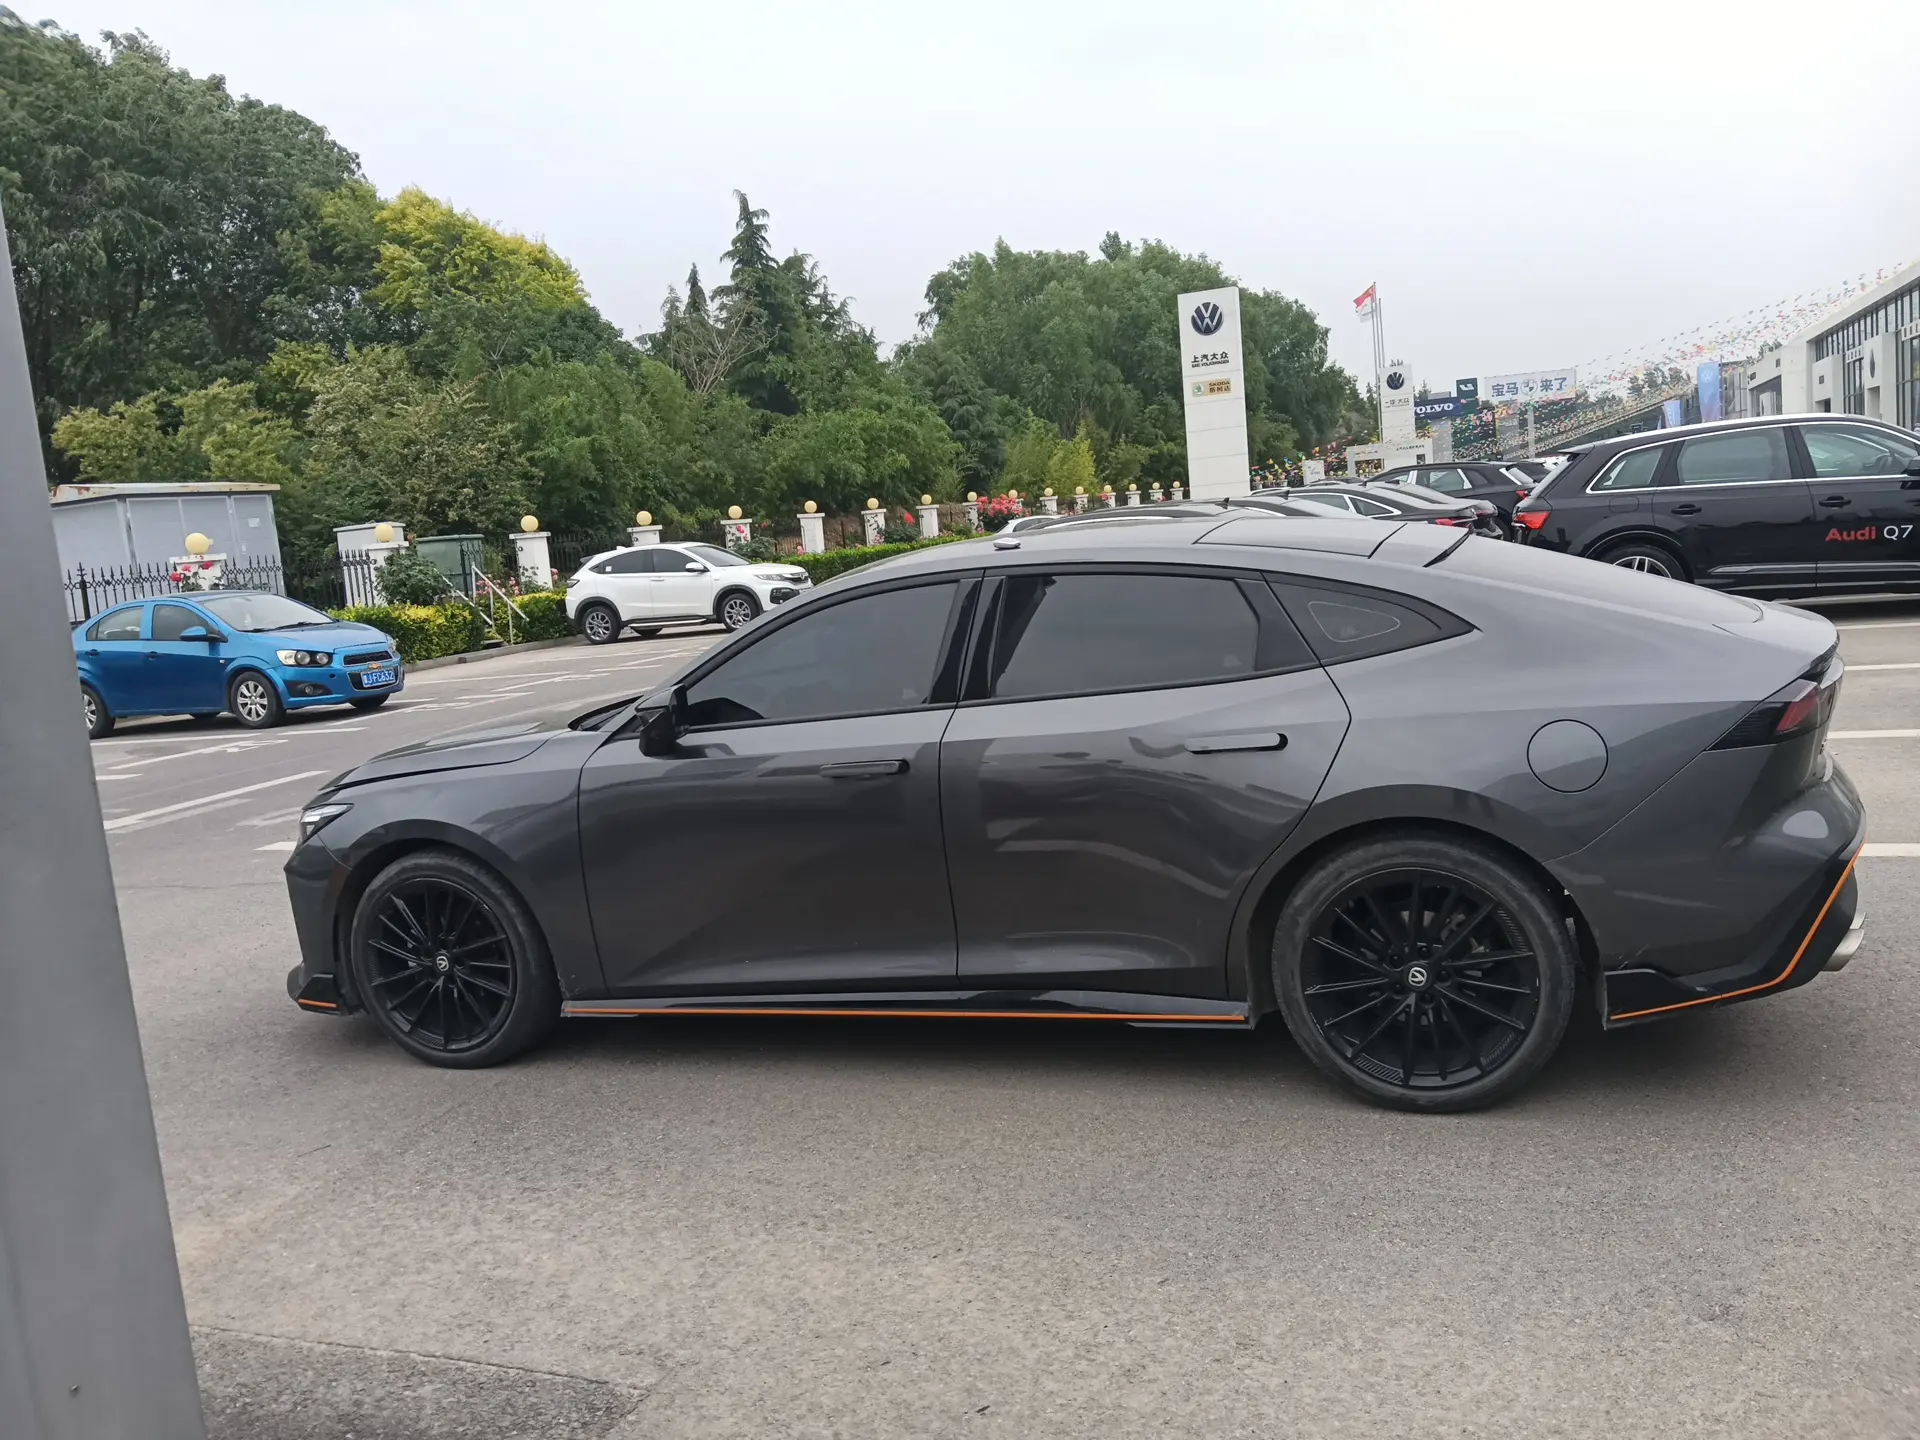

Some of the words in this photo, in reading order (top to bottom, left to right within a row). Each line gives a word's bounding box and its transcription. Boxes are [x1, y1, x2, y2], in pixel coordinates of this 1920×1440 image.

[1191, 351, 1229, 363] 上汽大众
[1492, 382, 1519, 397] 宝马
[1540, 377, 1567, 392] 来了
[1825, 526, 1877, 542] Audi
[1883, 525, 1914, 541] Q7
